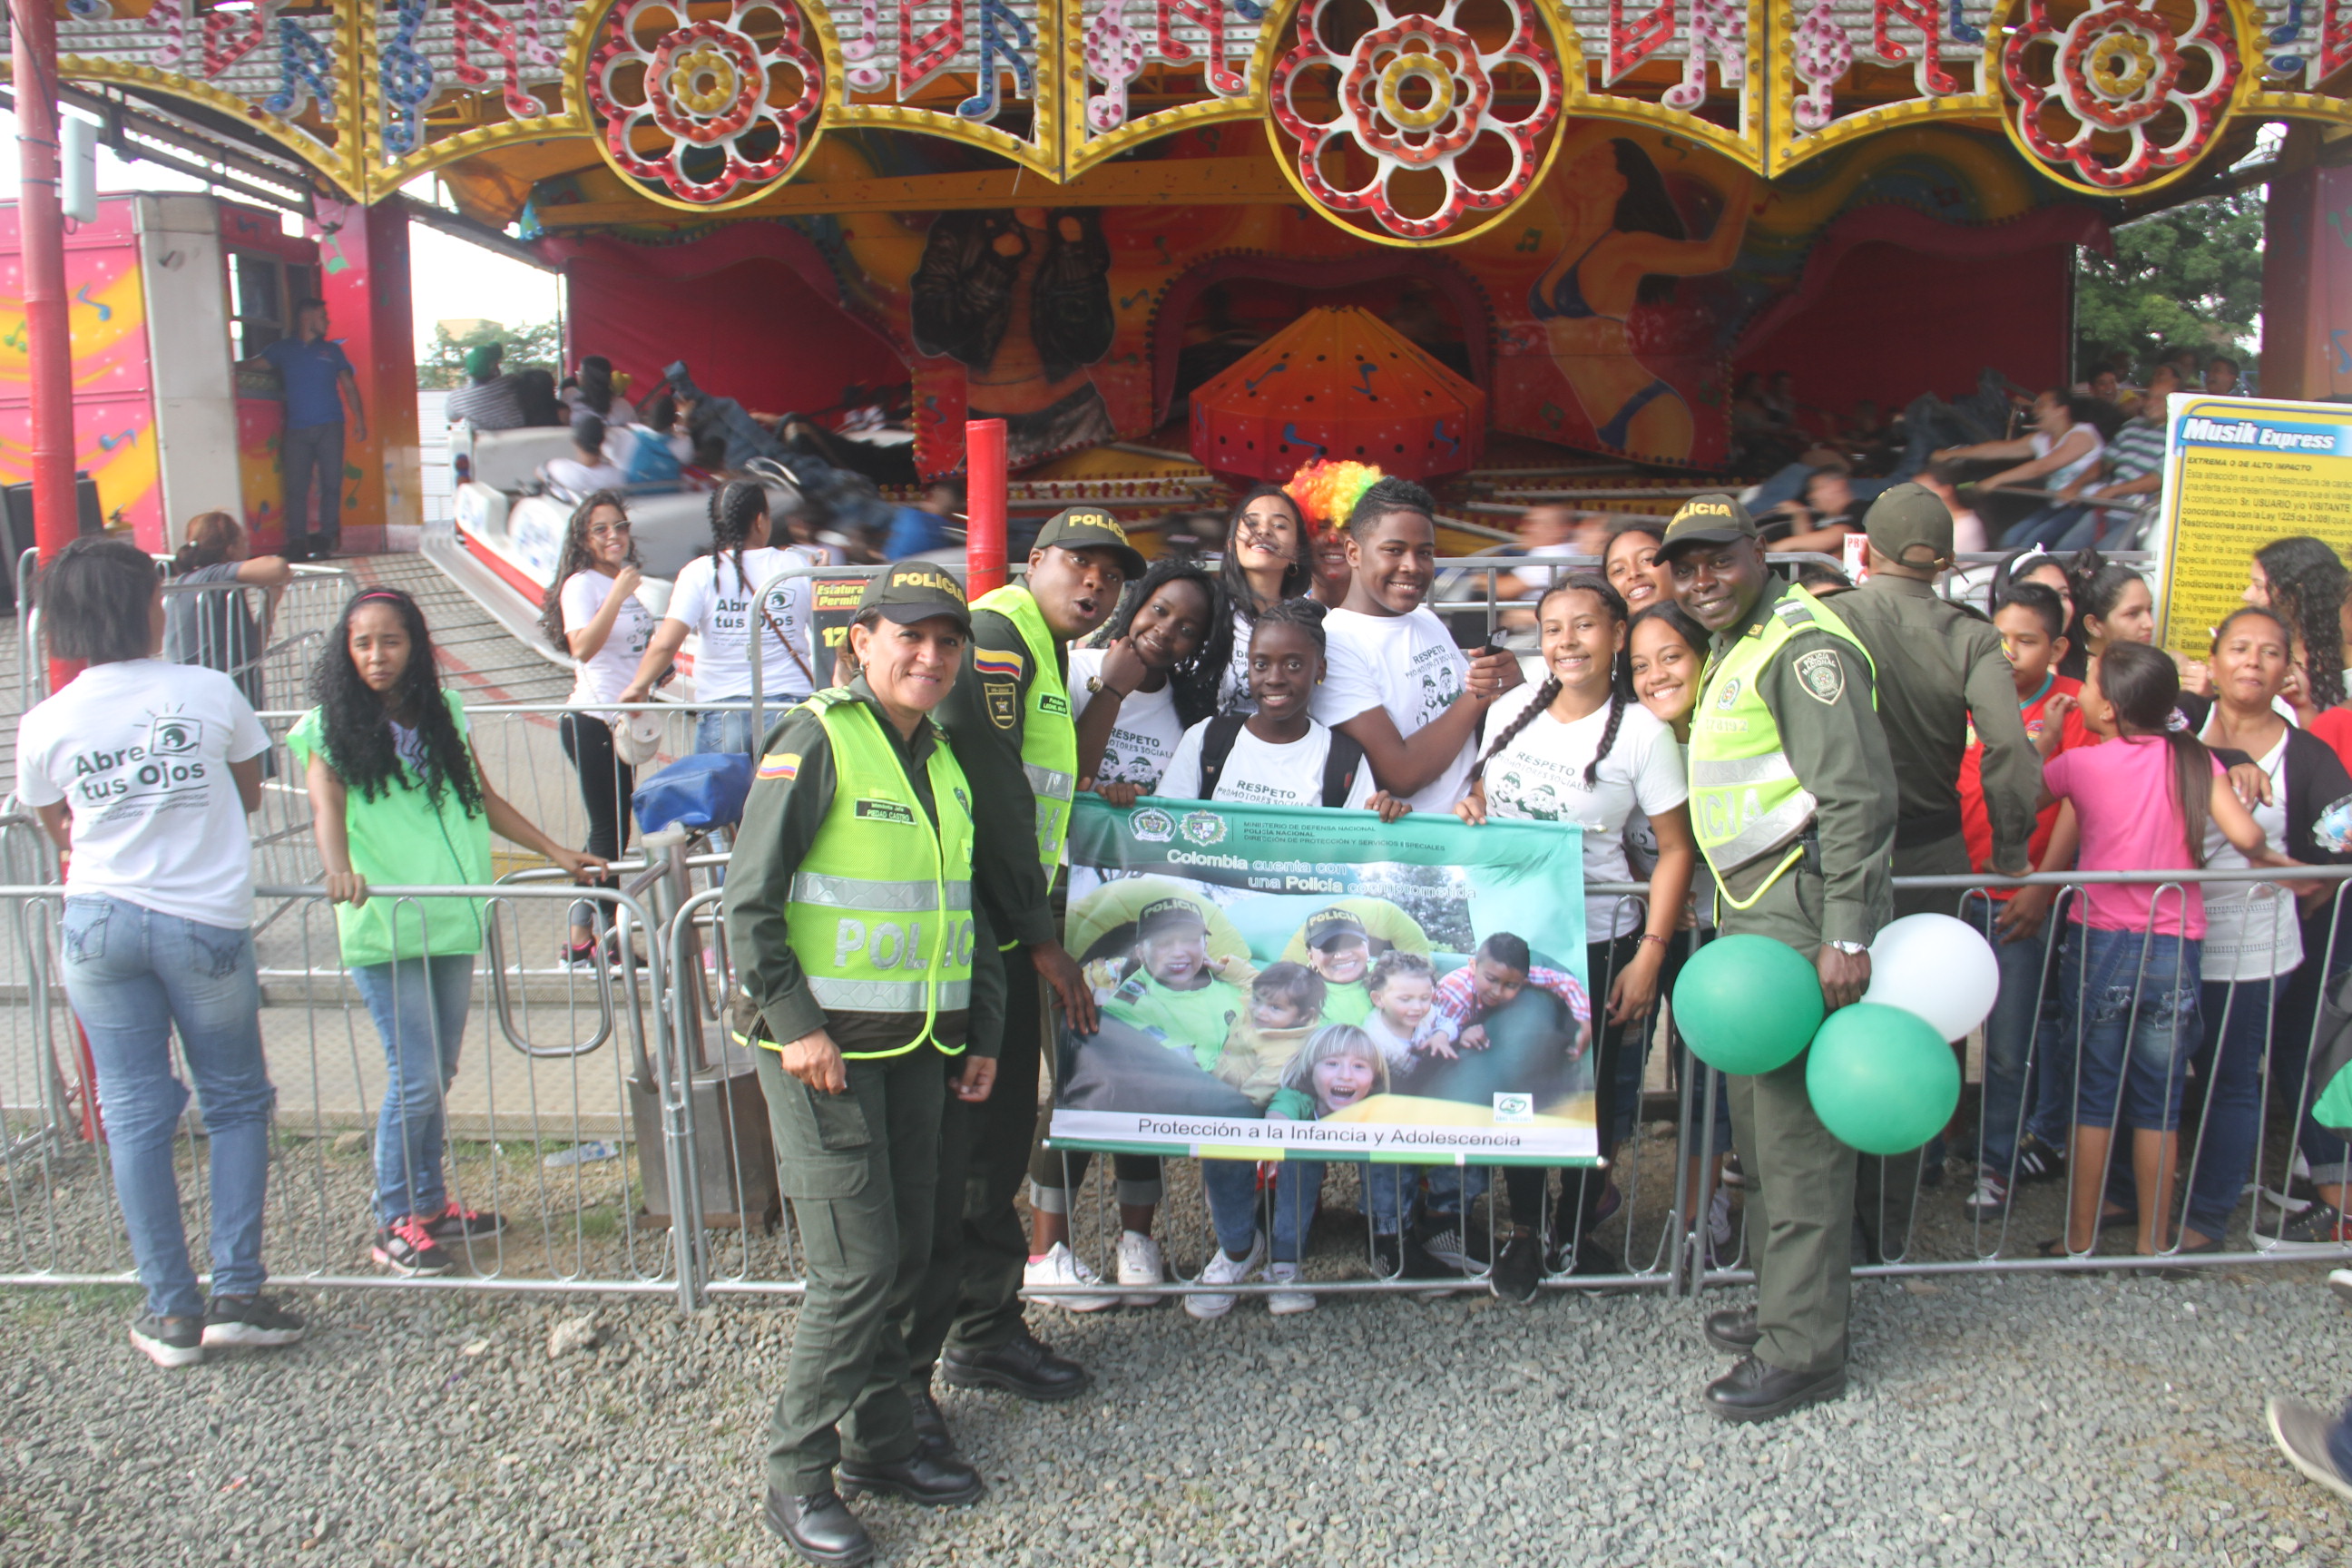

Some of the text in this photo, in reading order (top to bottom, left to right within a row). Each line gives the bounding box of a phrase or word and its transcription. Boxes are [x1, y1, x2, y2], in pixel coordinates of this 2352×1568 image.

[2181, 417, 2336, 450] Musik Express
[2187, 456, 2227, 466] EXTREMA
[2251, 461, 2273, 469] ALTO
[2275, 463, 2312, 471] IMPACTO
[2253, 498, 2290, 509] USUARIO
[2308, 501, 2350, 513] VISITANTE
[817, 584, 865, 595] Estatura
[2174, 579, 2223, 589] Condiciones
[716, 599, 750, 612] Abr
[818, 594, 861, 606] Permiti
[715, 615, 745, 628] tus
[1413, 644, 1446, 664] RESPETO
[1111, 728, 1160, 748] RESPETO
[76, 746, 146, 776] Abre
[1516, 751, 1575, 776] RESPETO
[82, 761, 205, 799] tus Ojos
[1237, 779, 1296, 799] RESPETO
[889, 811, 910, 821] CASTRO
[1167, 848, 1347, 875] Colombia cuenta con
[1249, 877, 1280, 889] una
[1285, 876, 1343, 893] Policía
[1138, 1117, 1520, 1146] Protección a la Infancia y Adolescencia
